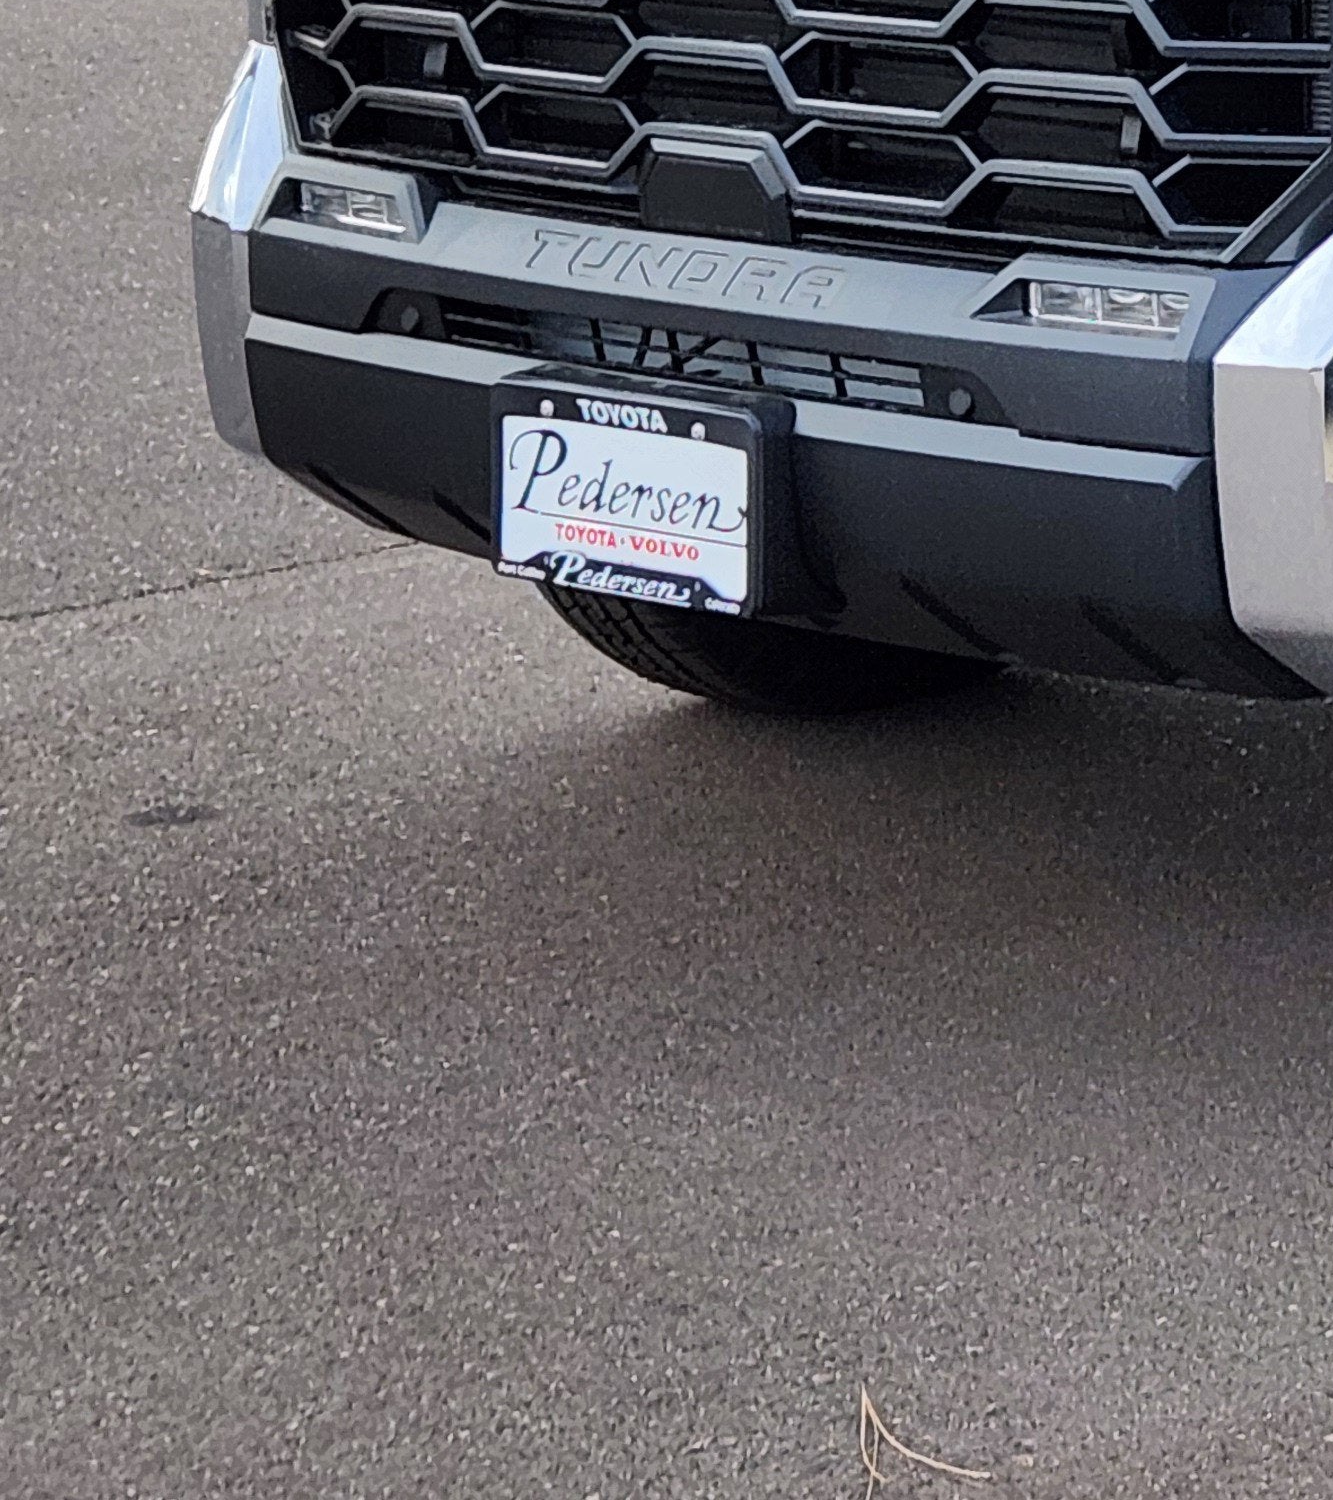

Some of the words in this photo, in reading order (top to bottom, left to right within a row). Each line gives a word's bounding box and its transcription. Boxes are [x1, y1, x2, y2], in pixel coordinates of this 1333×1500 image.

[525, 229, 846, 308] TUNDRA
[576, 398, 668, 434] TOYOTA
[509, 429, 748, 533] Pedersen
[555, 523, 617, 548] TOYOTA
[629, 535, 700, 560] VOLVO
[550, 550, 691, 603] Pedersen
